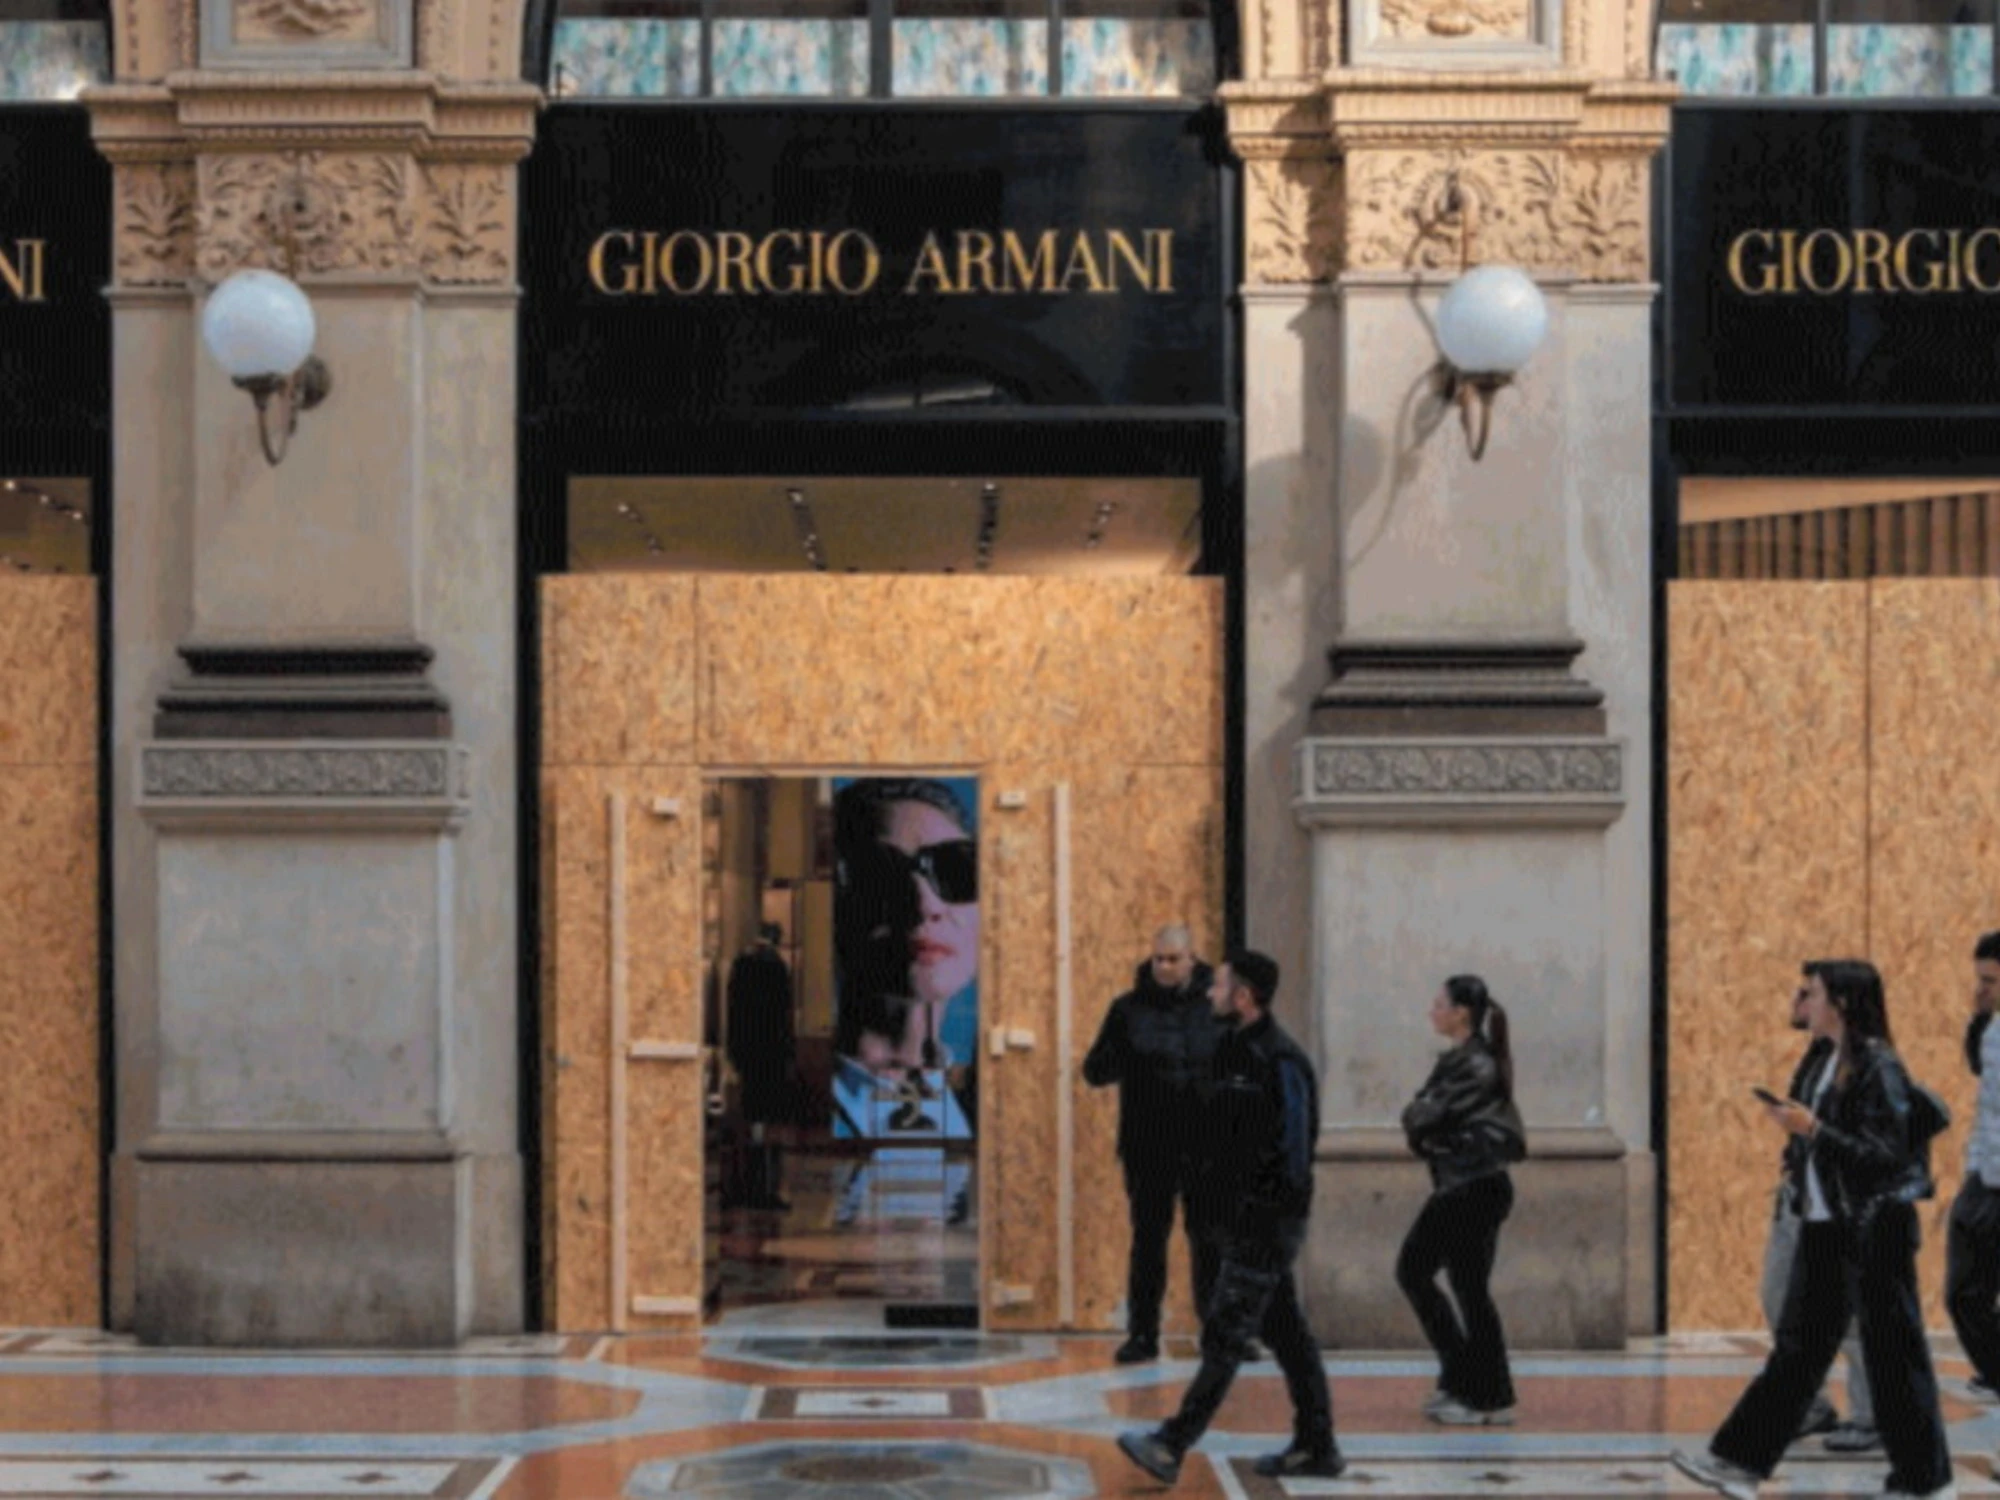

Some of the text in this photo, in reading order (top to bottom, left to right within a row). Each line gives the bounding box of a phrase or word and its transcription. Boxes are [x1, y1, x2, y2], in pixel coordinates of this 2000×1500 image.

[588, 229, 1174, 295] GIORGIO ARMANI
[1726, 228, 2000, 295] GIORGIO
